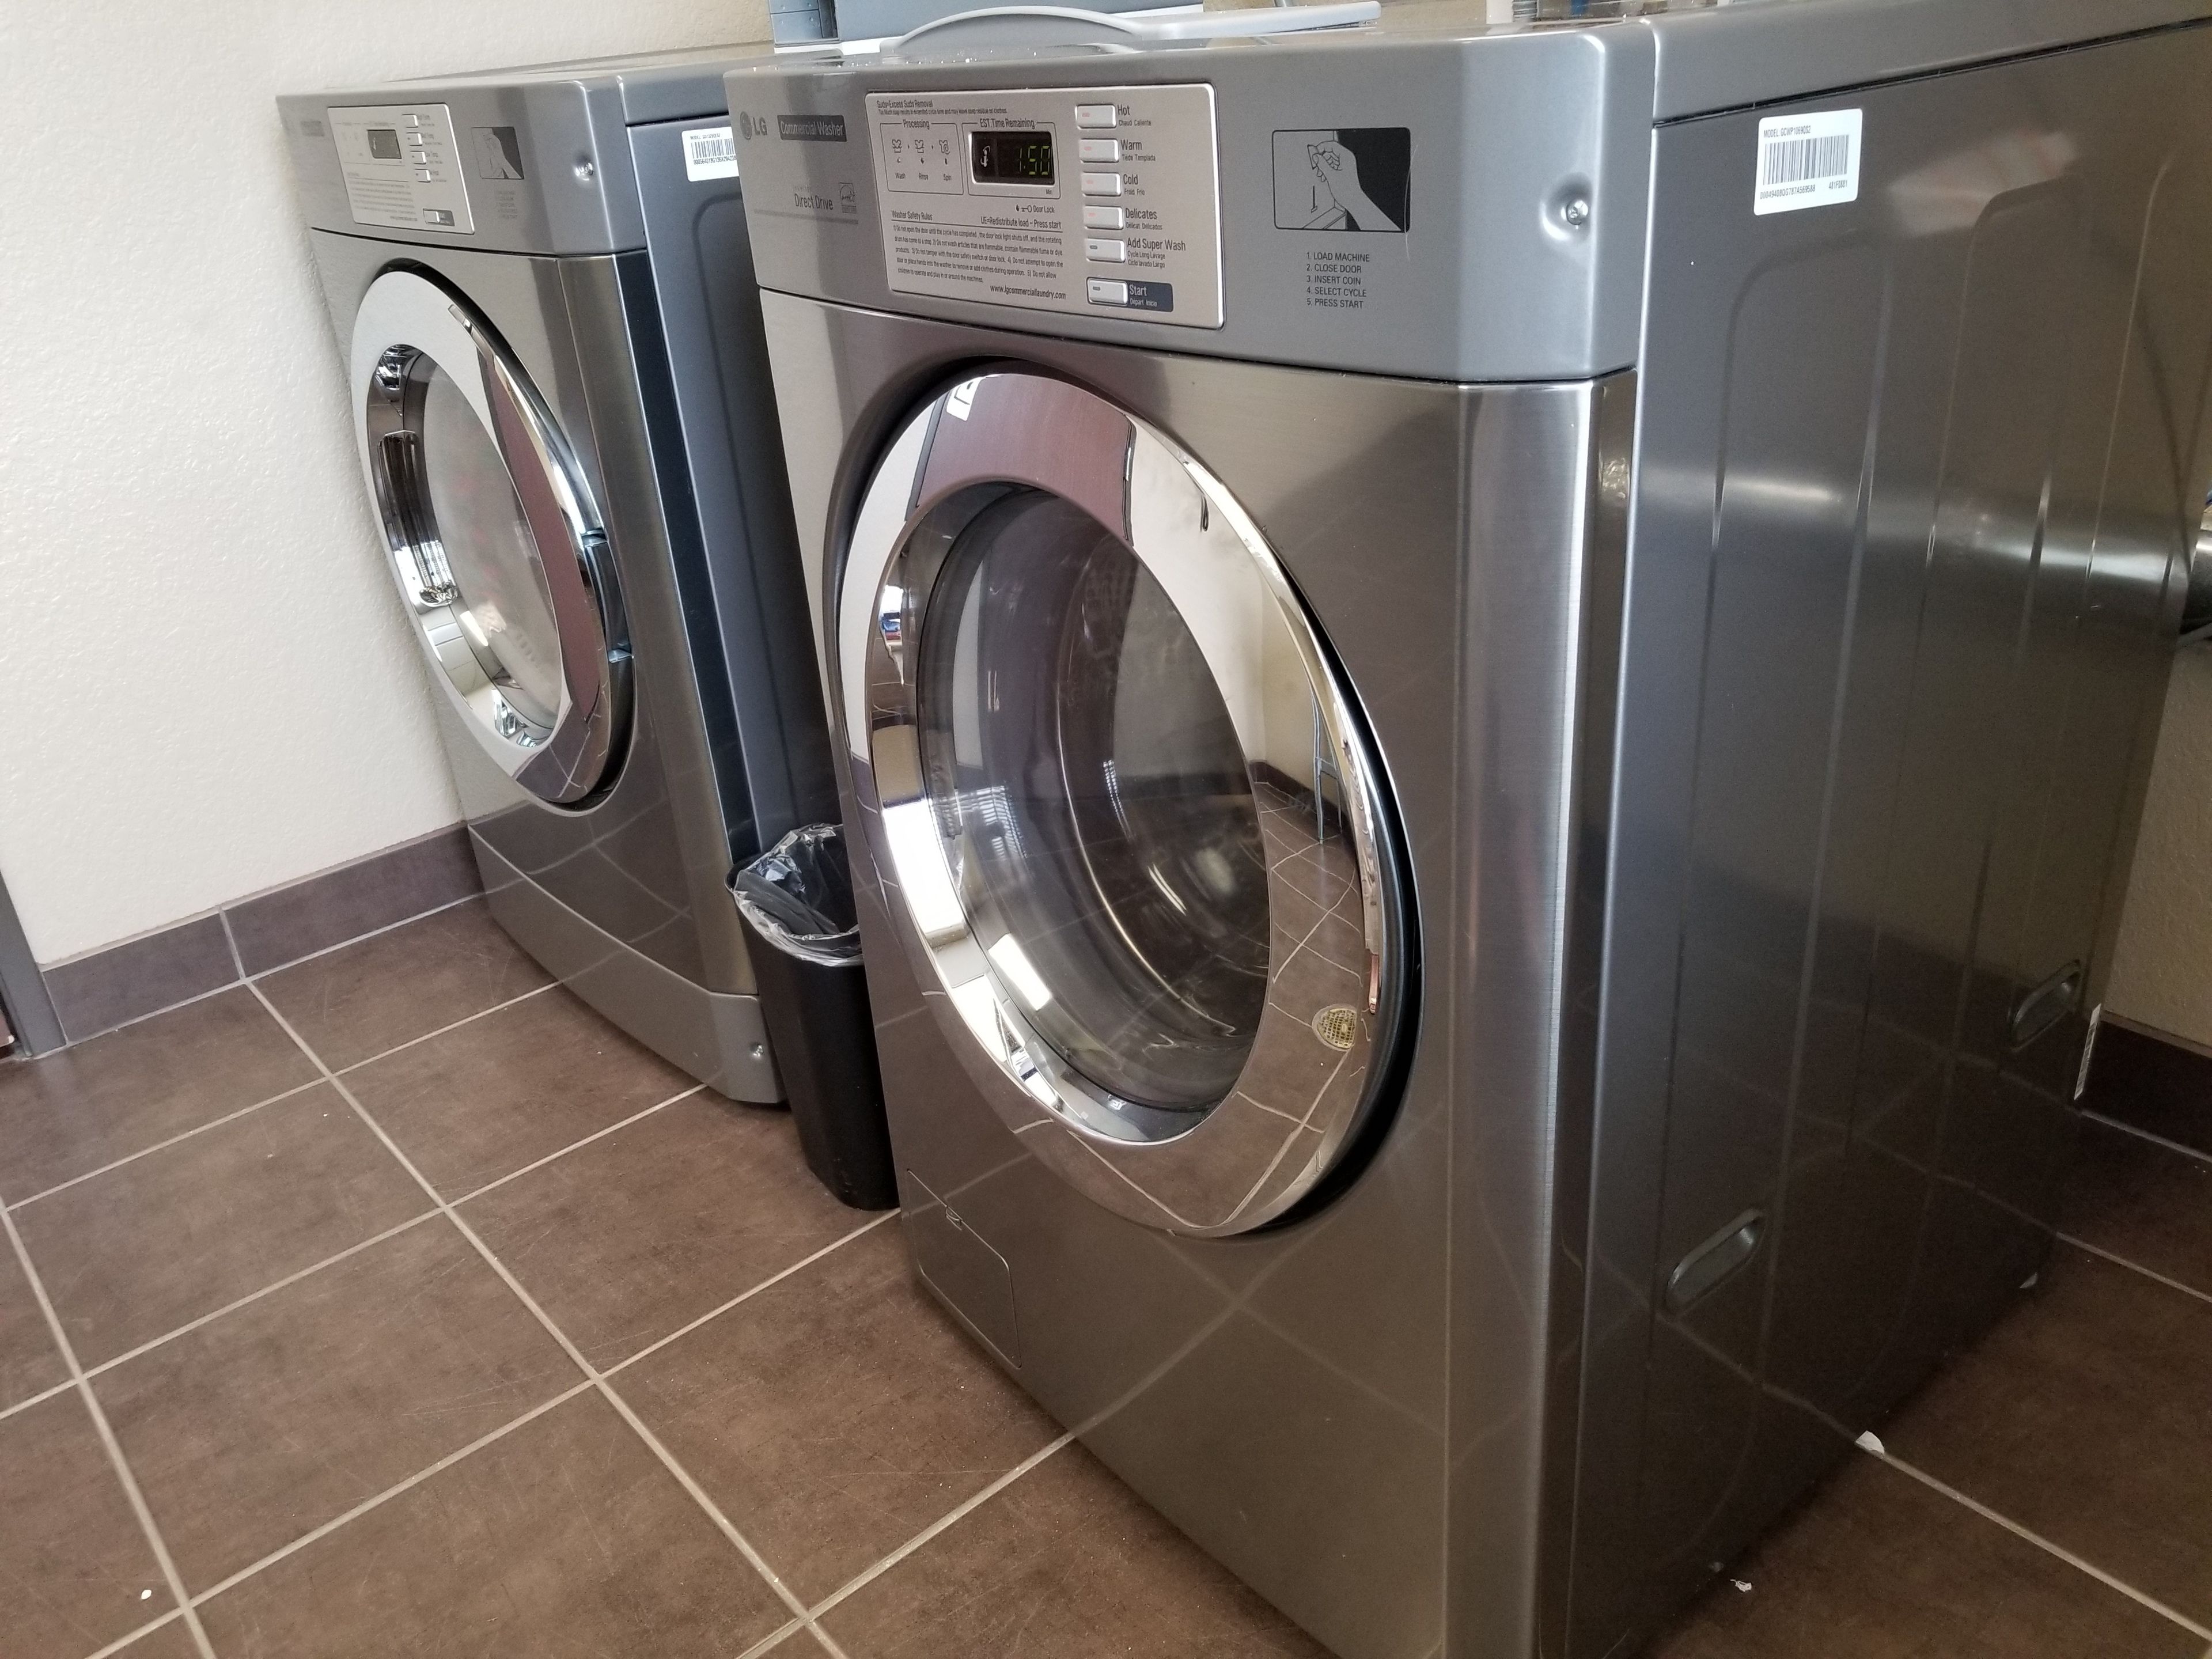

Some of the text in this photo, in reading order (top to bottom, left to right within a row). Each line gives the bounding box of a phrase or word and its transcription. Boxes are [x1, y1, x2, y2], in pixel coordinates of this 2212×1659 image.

[1117, 104, 1130, 116] Hot
[753, 117, 767, 135] LG
[780, 121, 844, 135] Commercial Washer
[903, 119, 930, 130] Processing
[1005, 119, 1036, 129] Remaining
[1120, 139, 1142, 150] Warm
[1123, 174, 1138, 185] Cold
[795, 193, 814, 209] Direct
[815, 195, 833, 210] Drive
[892, 210, 933, 221] Washer Safety Rules
[1125, 208, 1157, 219] Delicates
[1018, 218, 1029, 227] load
[1034, 219, 1048, 229] Press
[1049, 221, 1062, 229] start
[1127, 237, 1186, 251] Add Super Wash
[1313, 252, 1333, 260] LOAD
[1335, 252, 1370, 262] MACHINE
[1153, 261, 1165, 269] Largo
[1306, 263, 1361, 273] 2. CLOSE DOOR
[1315, 275, 1340, 284] INSERT
[1343, 276, 1361, 285] COIN
[990, 285, 1066, 300] www.lgcommerciallaundry.com
[1129, 284, 1147, 296] Start
[1315, 286, 1342, 296] SELECT
[1343, 289, 1367, 297] CYCLE
[1315, 298, 1338, 307] PRESS
[1340, 300, 1363, 309] START
